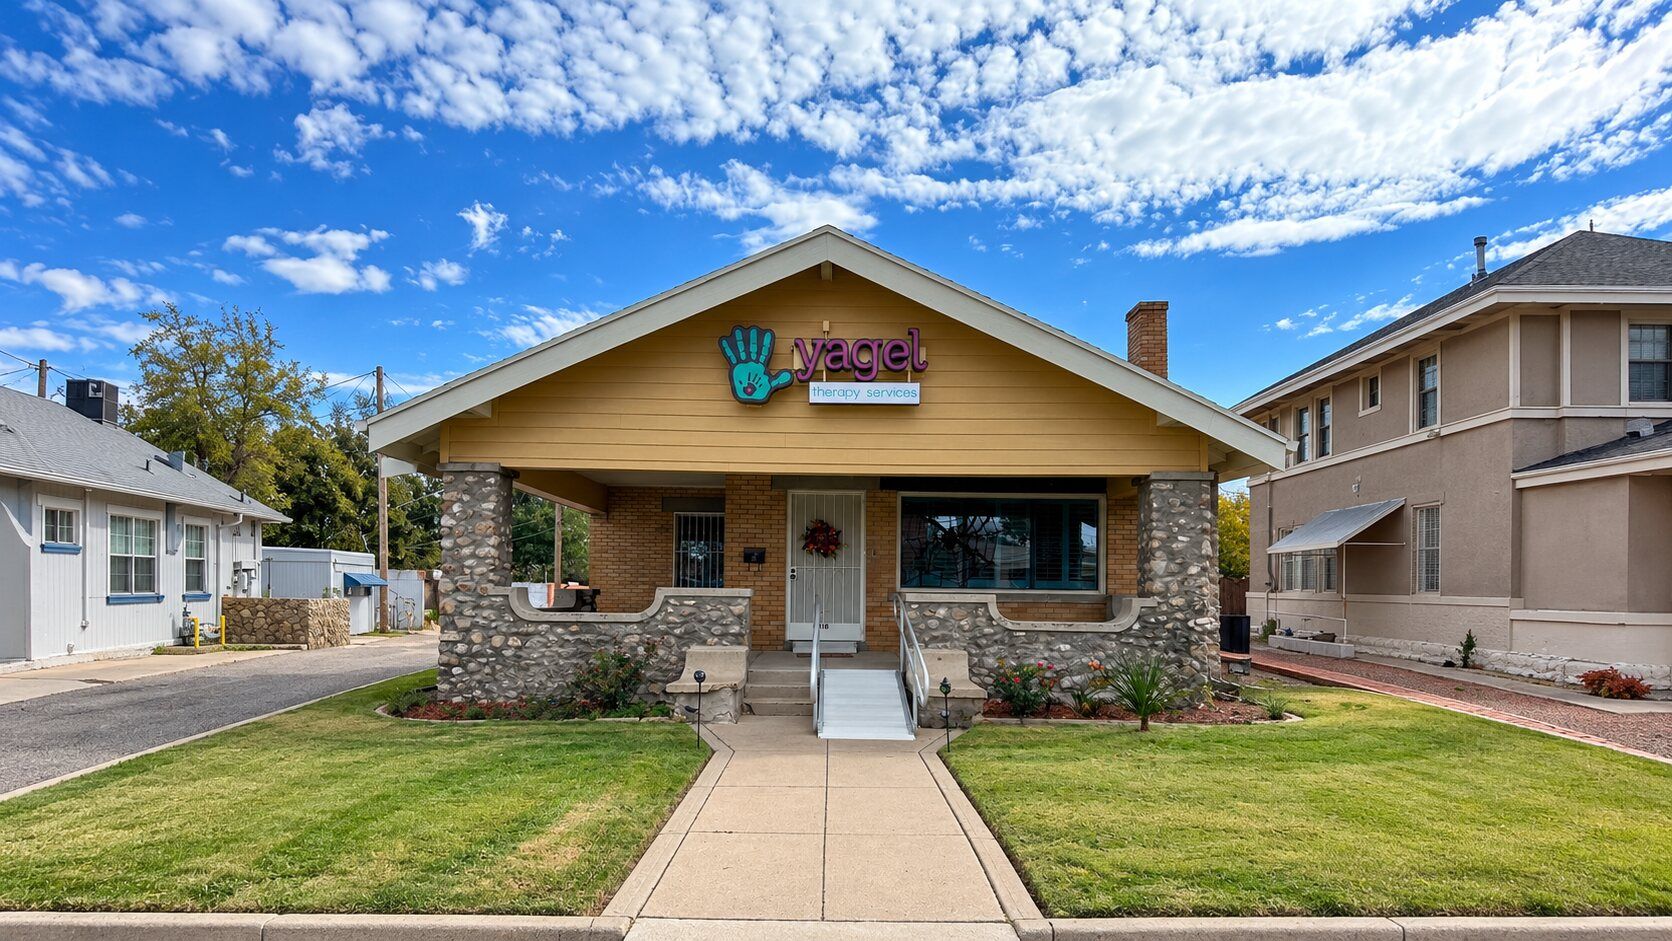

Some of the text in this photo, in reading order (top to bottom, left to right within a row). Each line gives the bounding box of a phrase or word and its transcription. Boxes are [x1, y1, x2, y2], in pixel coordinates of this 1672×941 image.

[794, 328, 928, 382] yagel
[812, 386, 918, 400] therapy services
